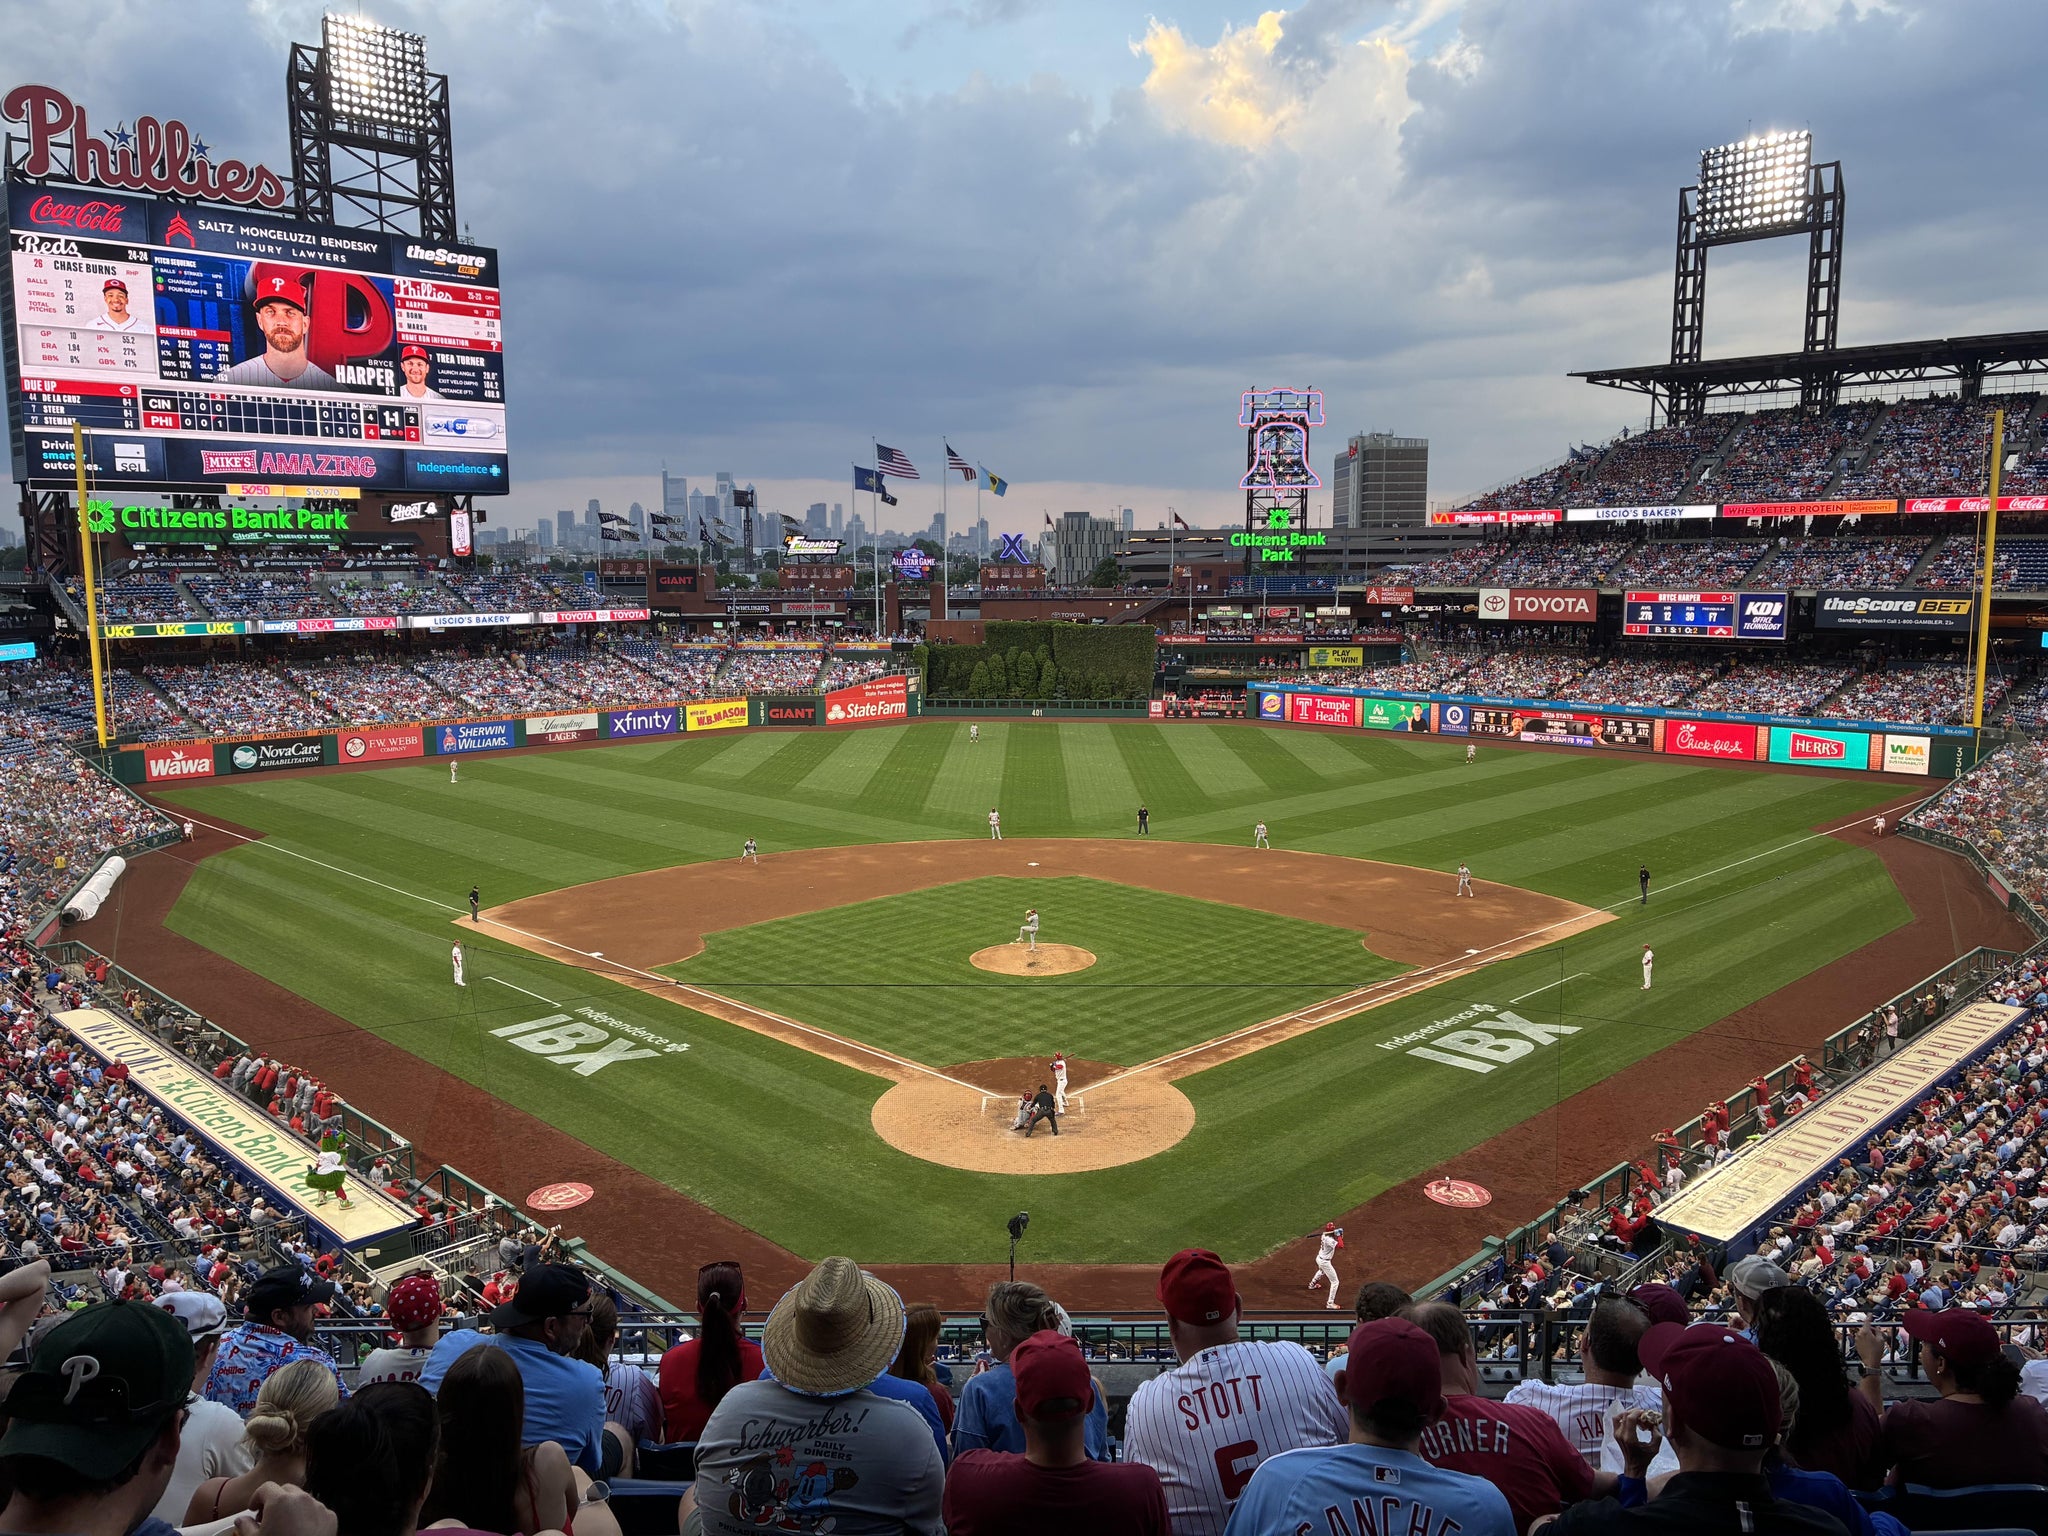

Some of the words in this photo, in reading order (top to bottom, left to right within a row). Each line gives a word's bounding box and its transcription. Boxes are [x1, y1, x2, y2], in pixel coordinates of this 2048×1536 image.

[1, 85, 287, 208] Phillies
[30, 195, 126, 232] Coca-Cola
[198, 220, 235, 234] SALTZ
[240, 225, 317, 246] MONGELUZZI
[321, 237, 378, 253] BENDESKY
[18, 234, 82, 258] Reds
[127, 250, 149, 262] 24-24
[236, 241, 283, 255] INJURY
[292, 248, 347, 264] LAWYERS
[406, 245, 487, 268] theScore
[34, 258, 43, 268] 26
[53, 260, 84, 273] CHASE
[86, 264, 117, 276] BURNS
[459, 266, 478, 275] BET
[65, 280, 73, 289] 12
[394, 278, 453, 301] Phillies
[27, 290, 55, 298] STRIKES
[65, 292, 74, 301] 23
[29, 306, 57, 314] PITCHES
[65, 305, 75, 314] 35
[122, 336, 136, 345] 55.2
[68, 344, 81, 352] 1.94
[123, 348, 137, 356] 27%
[124, 360, 137, 368] 47%
[368, 359, 394, 368] BRYCE
[435, 353, 456, 365] TREA
[456, 354, 485, 367] TURNER
[335, 364, 395, 388] HARPER
[24, 380, 42, 391] DUE
[44, 381, 57, 392] UP
[42, 395, 52, 403] DE
[52, 395, 62, 403] LA
[62, 396, 82, 404] CRUZ
[149, 398, 171, 410] CIN
[43, 405, 65, 414] STEER
[151, 415, 173, 427] PHI
[42, 440, 76, 450] Drivin
[42, 451, 87, 461] smartr
[43, 461, 103, 471] outcoes.
[209, 457, 251, 469] MIKE'S
[260, 452, 377, 478] AMAZING
[416, 462, 488, 475] Independence
[306, 488, 340, 497] $16,970
[390, 501, 428, 523] GHOST
[1728, 505, 1758, 515] WHEY
[1760, 504, 1797, 514] BETTER
[1799, 503, 1844, 513] PROTEIN
[1912, 500, 1948, 512] Coca-Cola
[120, 505, 228, 530] Citizens
[232, 507, 293, 531] Bank
[297, 508, 350, 531] Park
[1454, 514, 1481, 522] Phillies
[1481, 514, 1495, 522] win
[1511, 513, 1533, 521] Deals
[1533, 513, 1547, 521] roll
[1596, 509, 1638, 519] LISCIO'S
[1642, 508, 1685, 518] BAKERY
[1230, 533, 1288, 547] Citizens
[1290, 532, 1327, 547] Bank
[919, 557, 936, 566] GAME
[1261, 548, 1294, 563] Park
[659, 576, 694, 585] GIANT
[1658, 593, 1677, 602] BRYCE
[1677, 593, 1701, 602] HARPER
[1513, 597, 1590, 613] TOYOTA
[1745, 602, 1784, 616] KDI
[1824, 597, 1917, 612] theScore
[1922, 601, 1967, 612] BET
[433, 614, 473, 626] LISCIO'S
[475, 613, 511, 625] BAKERY
[559, 611, 595, 622] TOYOTA
[612, 610, 646, 620] TOYOTA
[1752, 616, 1774, 624] OFFICE
[206, 622, 235, 634] UKG
[300, 620, 334, 631] NECA
[367, 618, 396, 629] NECA
[1743, 622, 1783, 631] TECHNOLOGY
[104, 626, 135, 638] UKG
[156, 624, 186, 636] UKG
[1340, 656, 1359, 664] WIN!
[1315, 698, 1351, 711] Temple
[769, 708, 816, 720] GIANT
[1031, 708, 1043, 717] 401
[1315, 711, 1349, 724] Health
[418, 719, 458, 728] ASPLUNDH
[465, 716, 503, 724] ASPLUNDH
[540, 715, 585, 732] Yuengling
[613, 711, 673, 734] xfinity
[317, 727, 361, 736] ASPLUNDH
[368, 723, 412, 732] ASPLUNDH
[458, 725, 507, 738] SHERWIN
[1944, 727, 1969, 736] ibx.com
[205, 735, 253, 745] ASPLUNDH
[262, 731, 308, 740] ASPLUNDH
[548, 731, 578, 742] LAGER
[1535, 733, 1567, 744] FOUR-SEAM
[145, 739, 196, 750] ASPLUNDH
[369, 739, 386, 749] F.W.
[388, 735, 418, 746] WEBB
[1796, 740, 1839, 756] HERR'S
[259, 742, 322, 760] NovaCare
[380, 745, 408, 753] COMPANY
[150, 756, 210, 777] Wawa
[259, 755, 320, 768] REHABILITATION
[574, 1006, 670, 1046] Independence
[1376, 1005, 1480, 1050] Independence
[488, 1013, 663, 1077] IBX
[1405, 1010, 1584, 1074] IBX
[80, 1021, 173, 1081] WELCOME
[1757, 1058, 1940, 1175] PHILADELPHIA
[1921, 1006, 2012, 1061] PHILLIES
[174, 1088, 247, 1142] Citizens
[233, 1128, 299, 1175] Bank
[61, 1355, 100, 1406] P
[1177, 1374, 1263, 1432] STOTT
[730, 1406, 870, 1456] Schwarber!
[814, 1440, 846, 1451] DAILY
[1420, 1419, 1510, 1460] URNER
[803, 1447, 853, 1462] DINGERS
